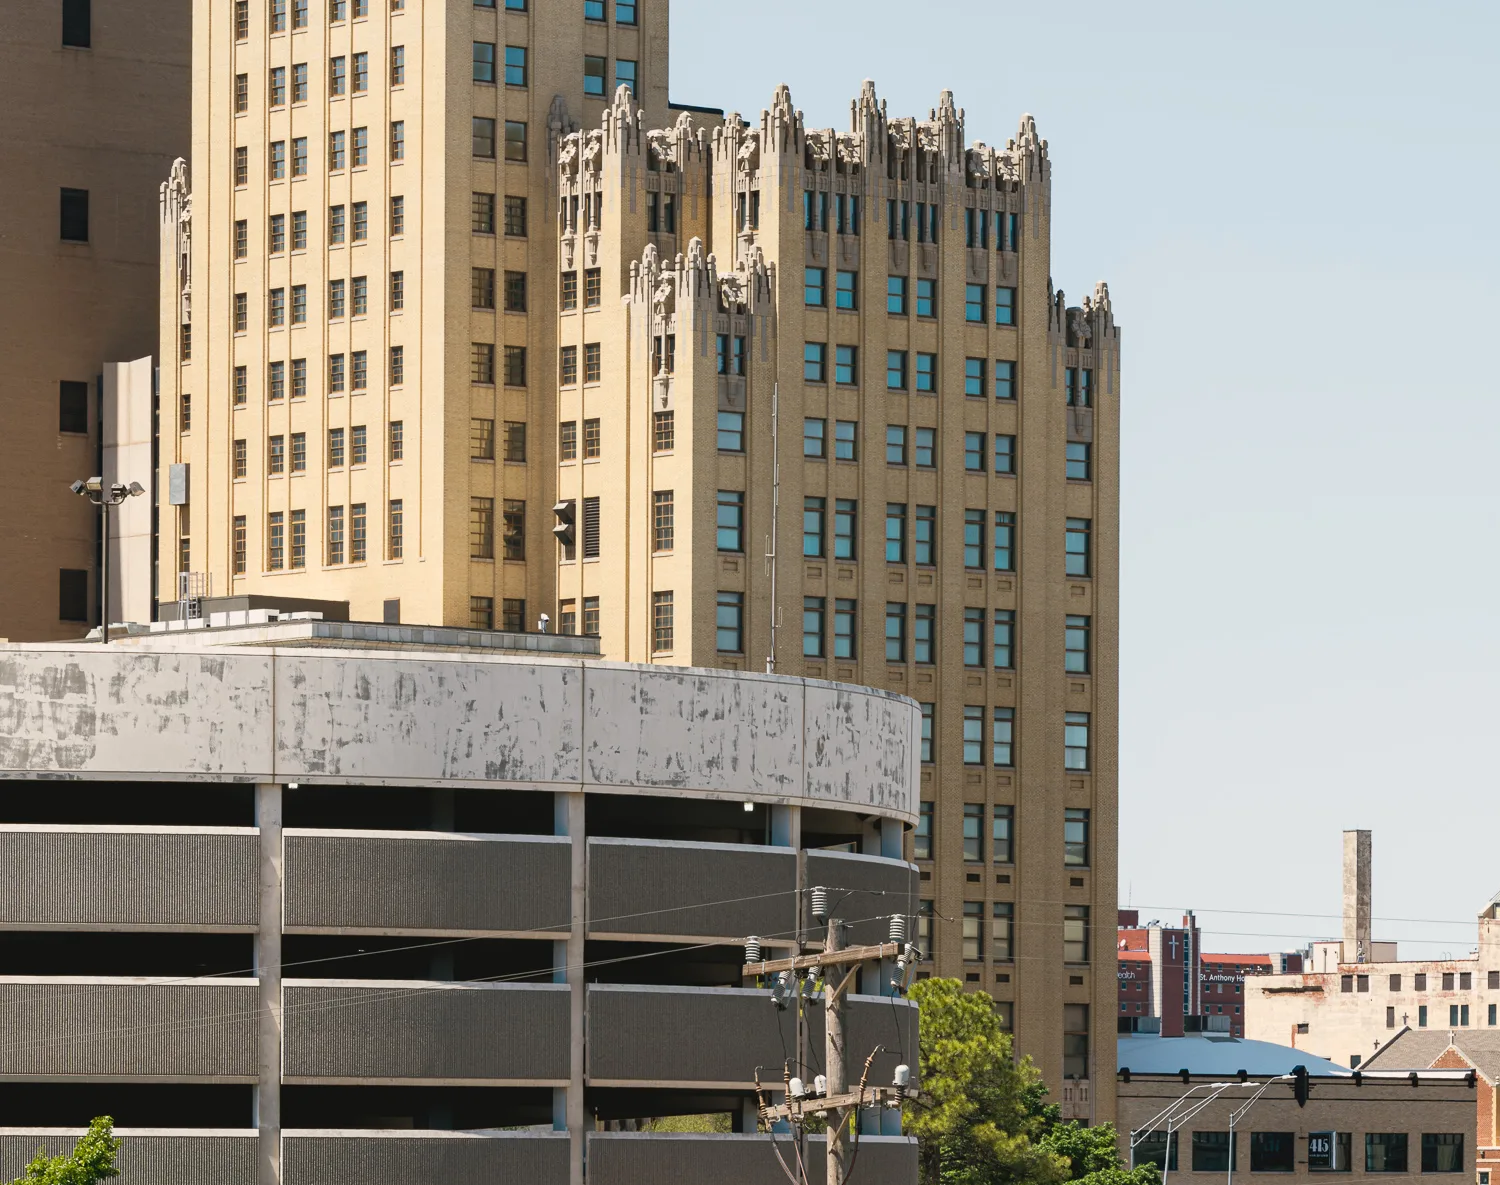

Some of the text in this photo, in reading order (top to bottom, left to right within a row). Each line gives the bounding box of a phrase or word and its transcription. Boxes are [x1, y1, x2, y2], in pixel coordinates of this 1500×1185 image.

[1118, 971, 1135, 979] ealth
[1209, 974, 1235, 982] Anthony
[1310, 1139, 1329, 1152] 415
